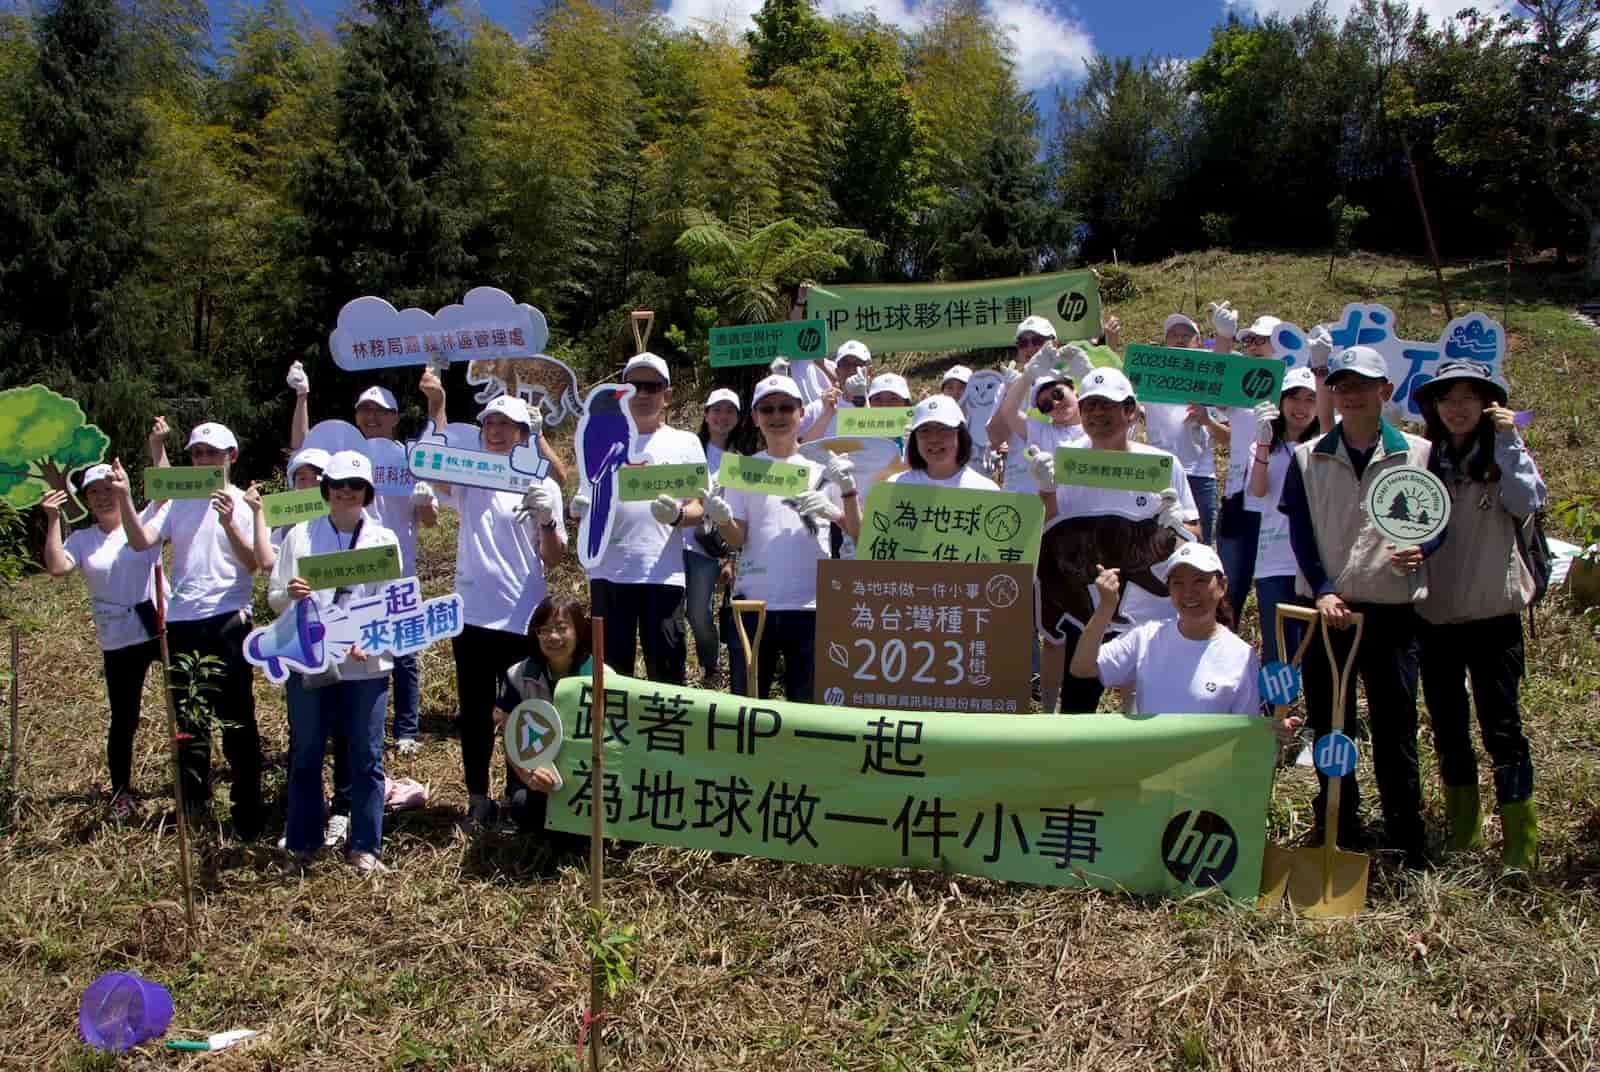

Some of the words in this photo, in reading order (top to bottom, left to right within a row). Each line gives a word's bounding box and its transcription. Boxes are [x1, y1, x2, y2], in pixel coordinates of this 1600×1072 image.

[1057, 292, 1088, 322] hp
[798, 327, 821, 352] hp
[1242, 367, 1275, 399] hp
[893, 500, 982, 536] 為地球
[350, 582, 417, 616] 一起
[853, 579, 979, 599] 為地球做一件小事
[359, 599, 459, 651] 來種樹
[851, 602, 991, 633] 為台灣種下
[853, 638, 965, 685] 2023
[824, 687, 845, 705] hp
[1262, 664, 1294, 704] hp
[1161, 809, 1239, 888] hp
